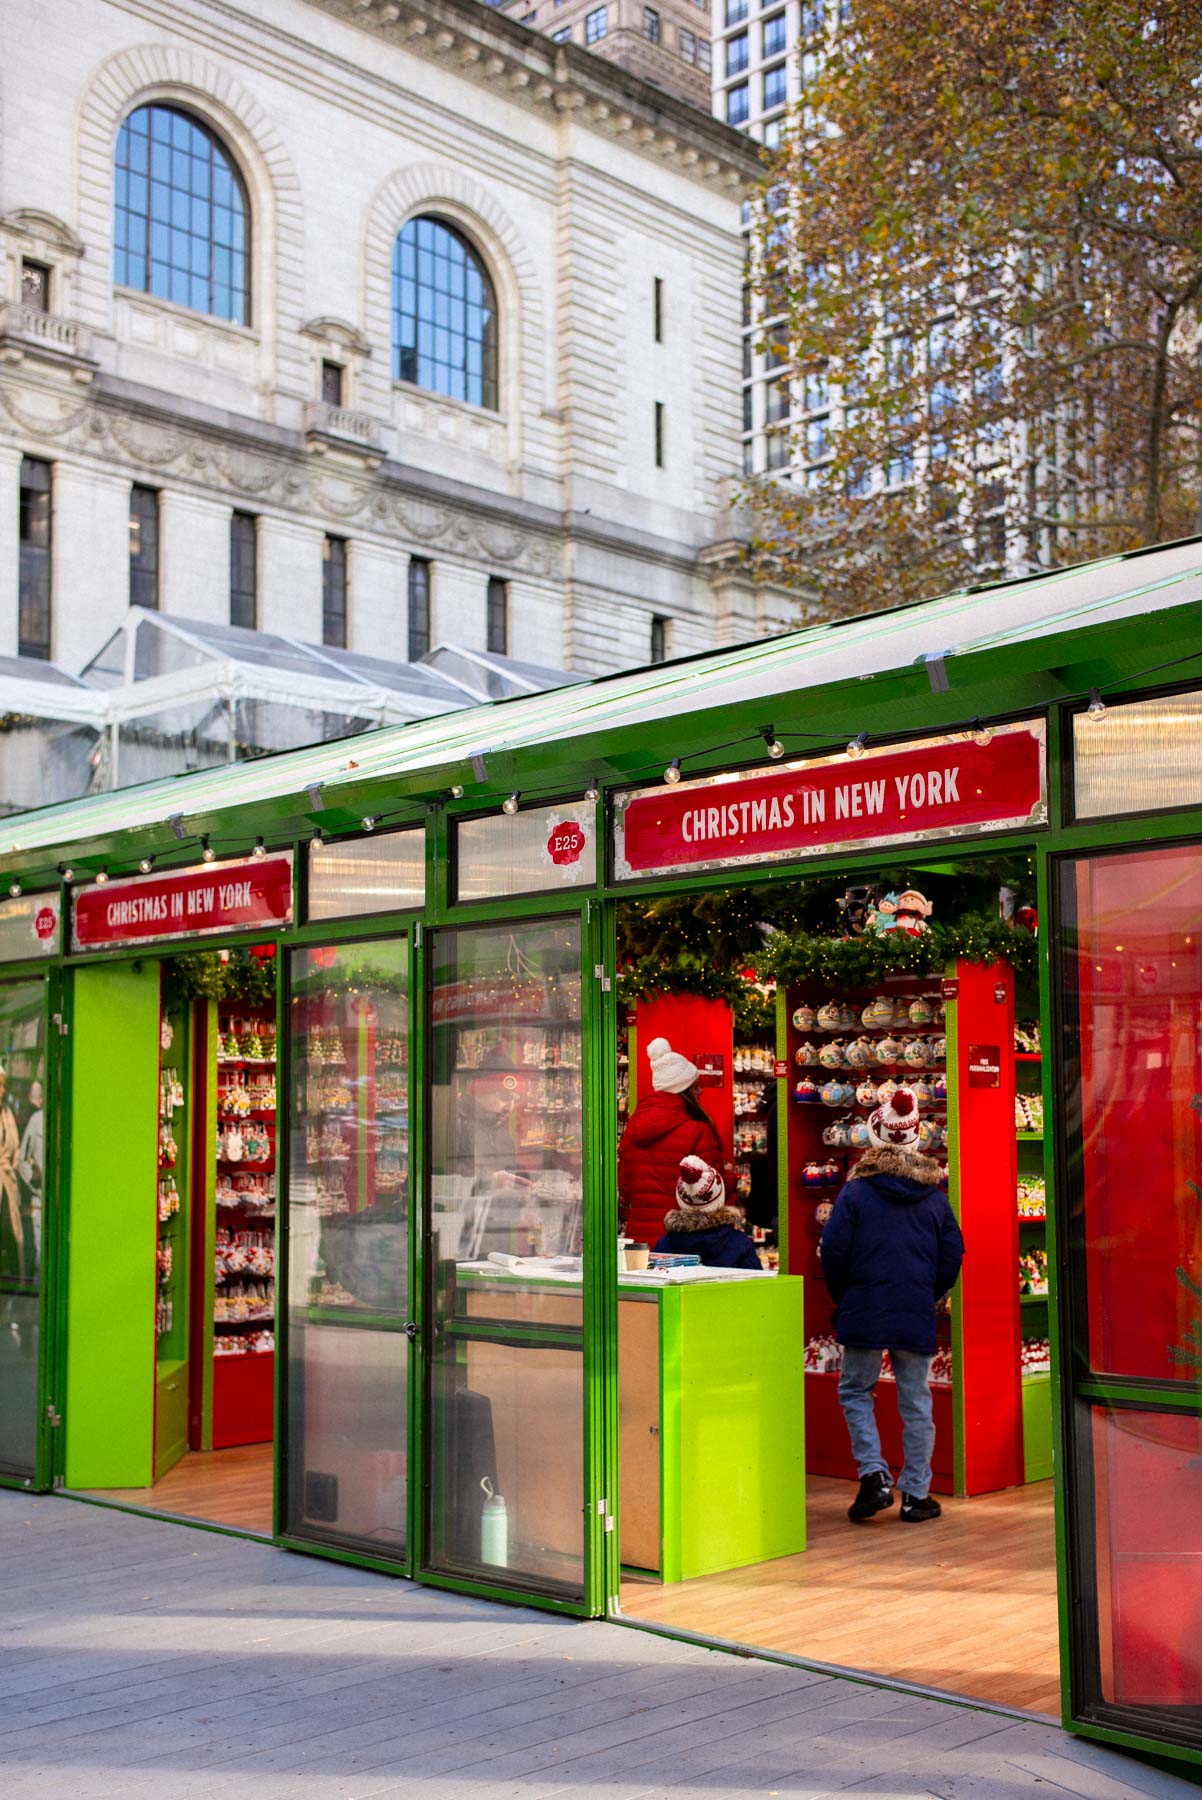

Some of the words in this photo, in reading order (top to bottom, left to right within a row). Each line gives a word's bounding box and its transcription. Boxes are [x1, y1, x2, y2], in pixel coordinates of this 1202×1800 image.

[682, 795, 795, 842] CHRISTMAS
[803, 789, 825, 824] IN
[835, 779, 886, 820] NEW
[895, 767, 960, 811] YORK
[555, 834, 579, 851] E25
[106, 894, 168, 927] CHRISTMAS
[170, 892, 184, 918] IN
[187, 887, 215, 916] NEW
[218, 881, 252, 910] YORK
